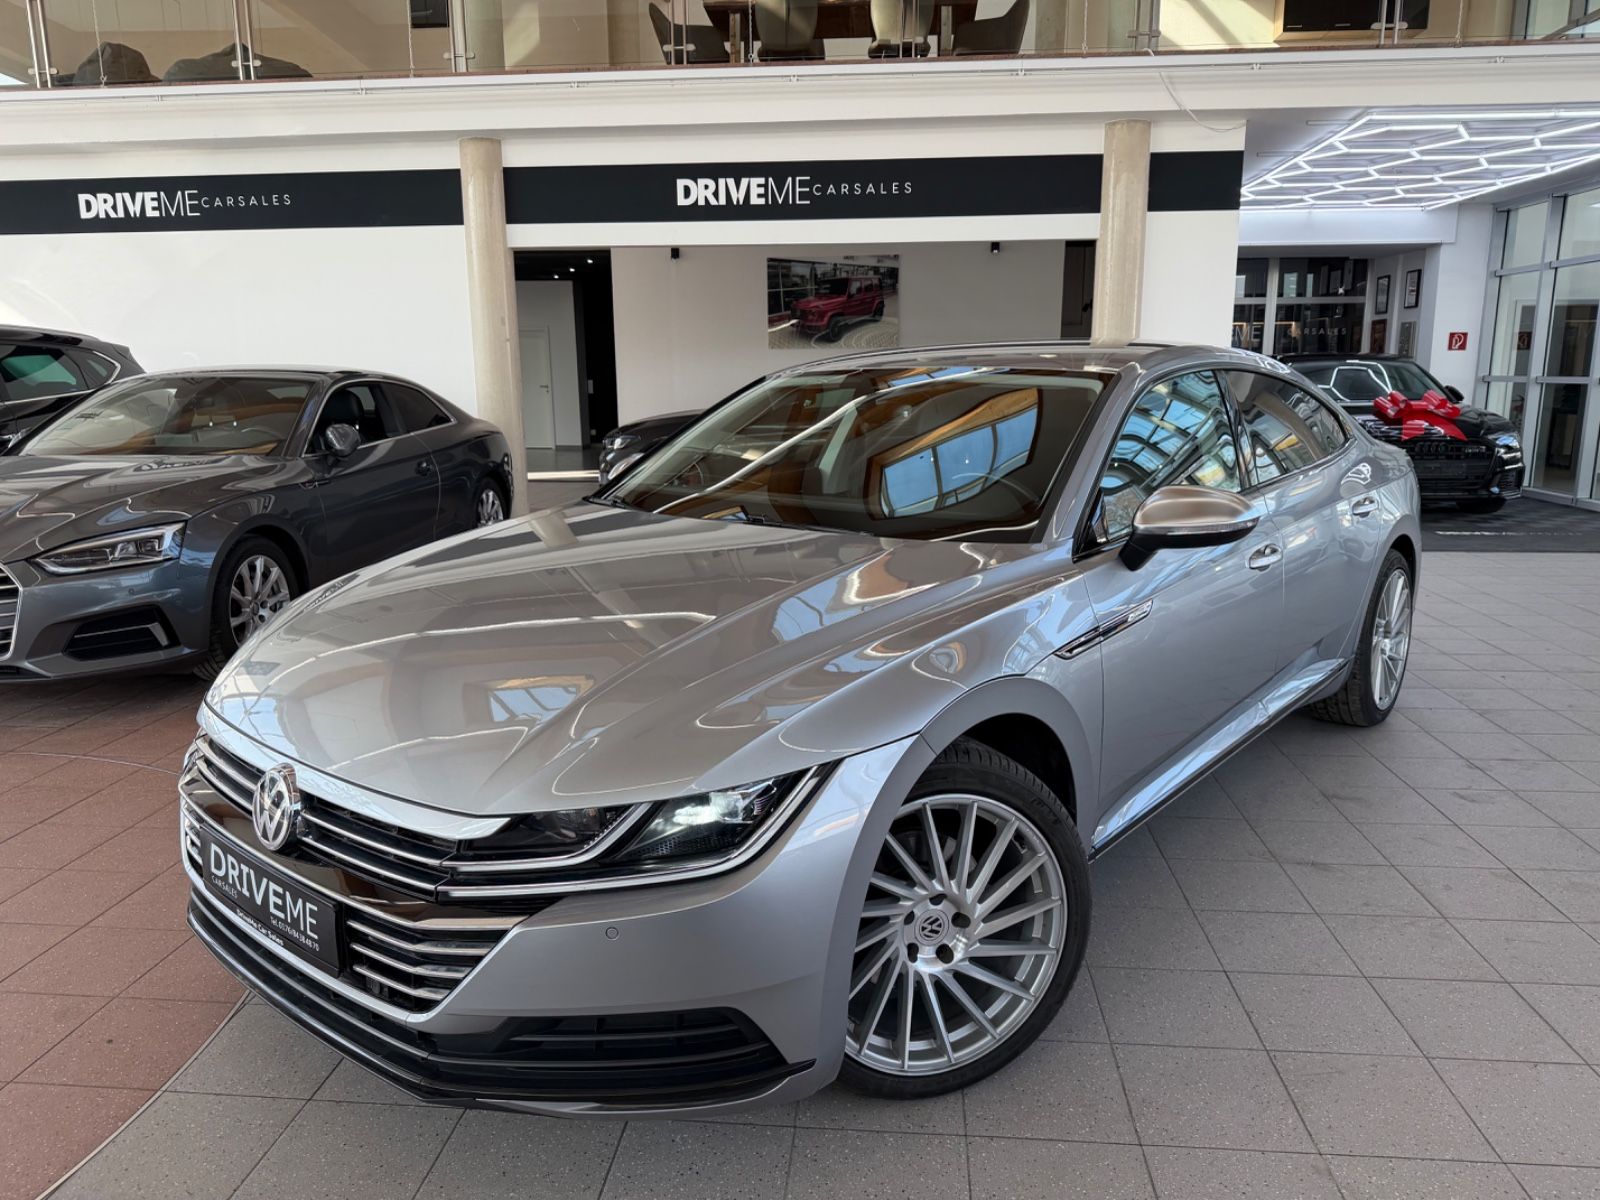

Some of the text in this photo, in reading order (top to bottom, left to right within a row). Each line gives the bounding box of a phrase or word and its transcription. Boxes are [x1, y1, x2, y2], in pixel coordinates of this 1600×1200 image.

[812, 181, 913, 196] CARSALES
[201, 194, 291, 208] CARSALES
[210, 843, 319, 940] DRIVEME
